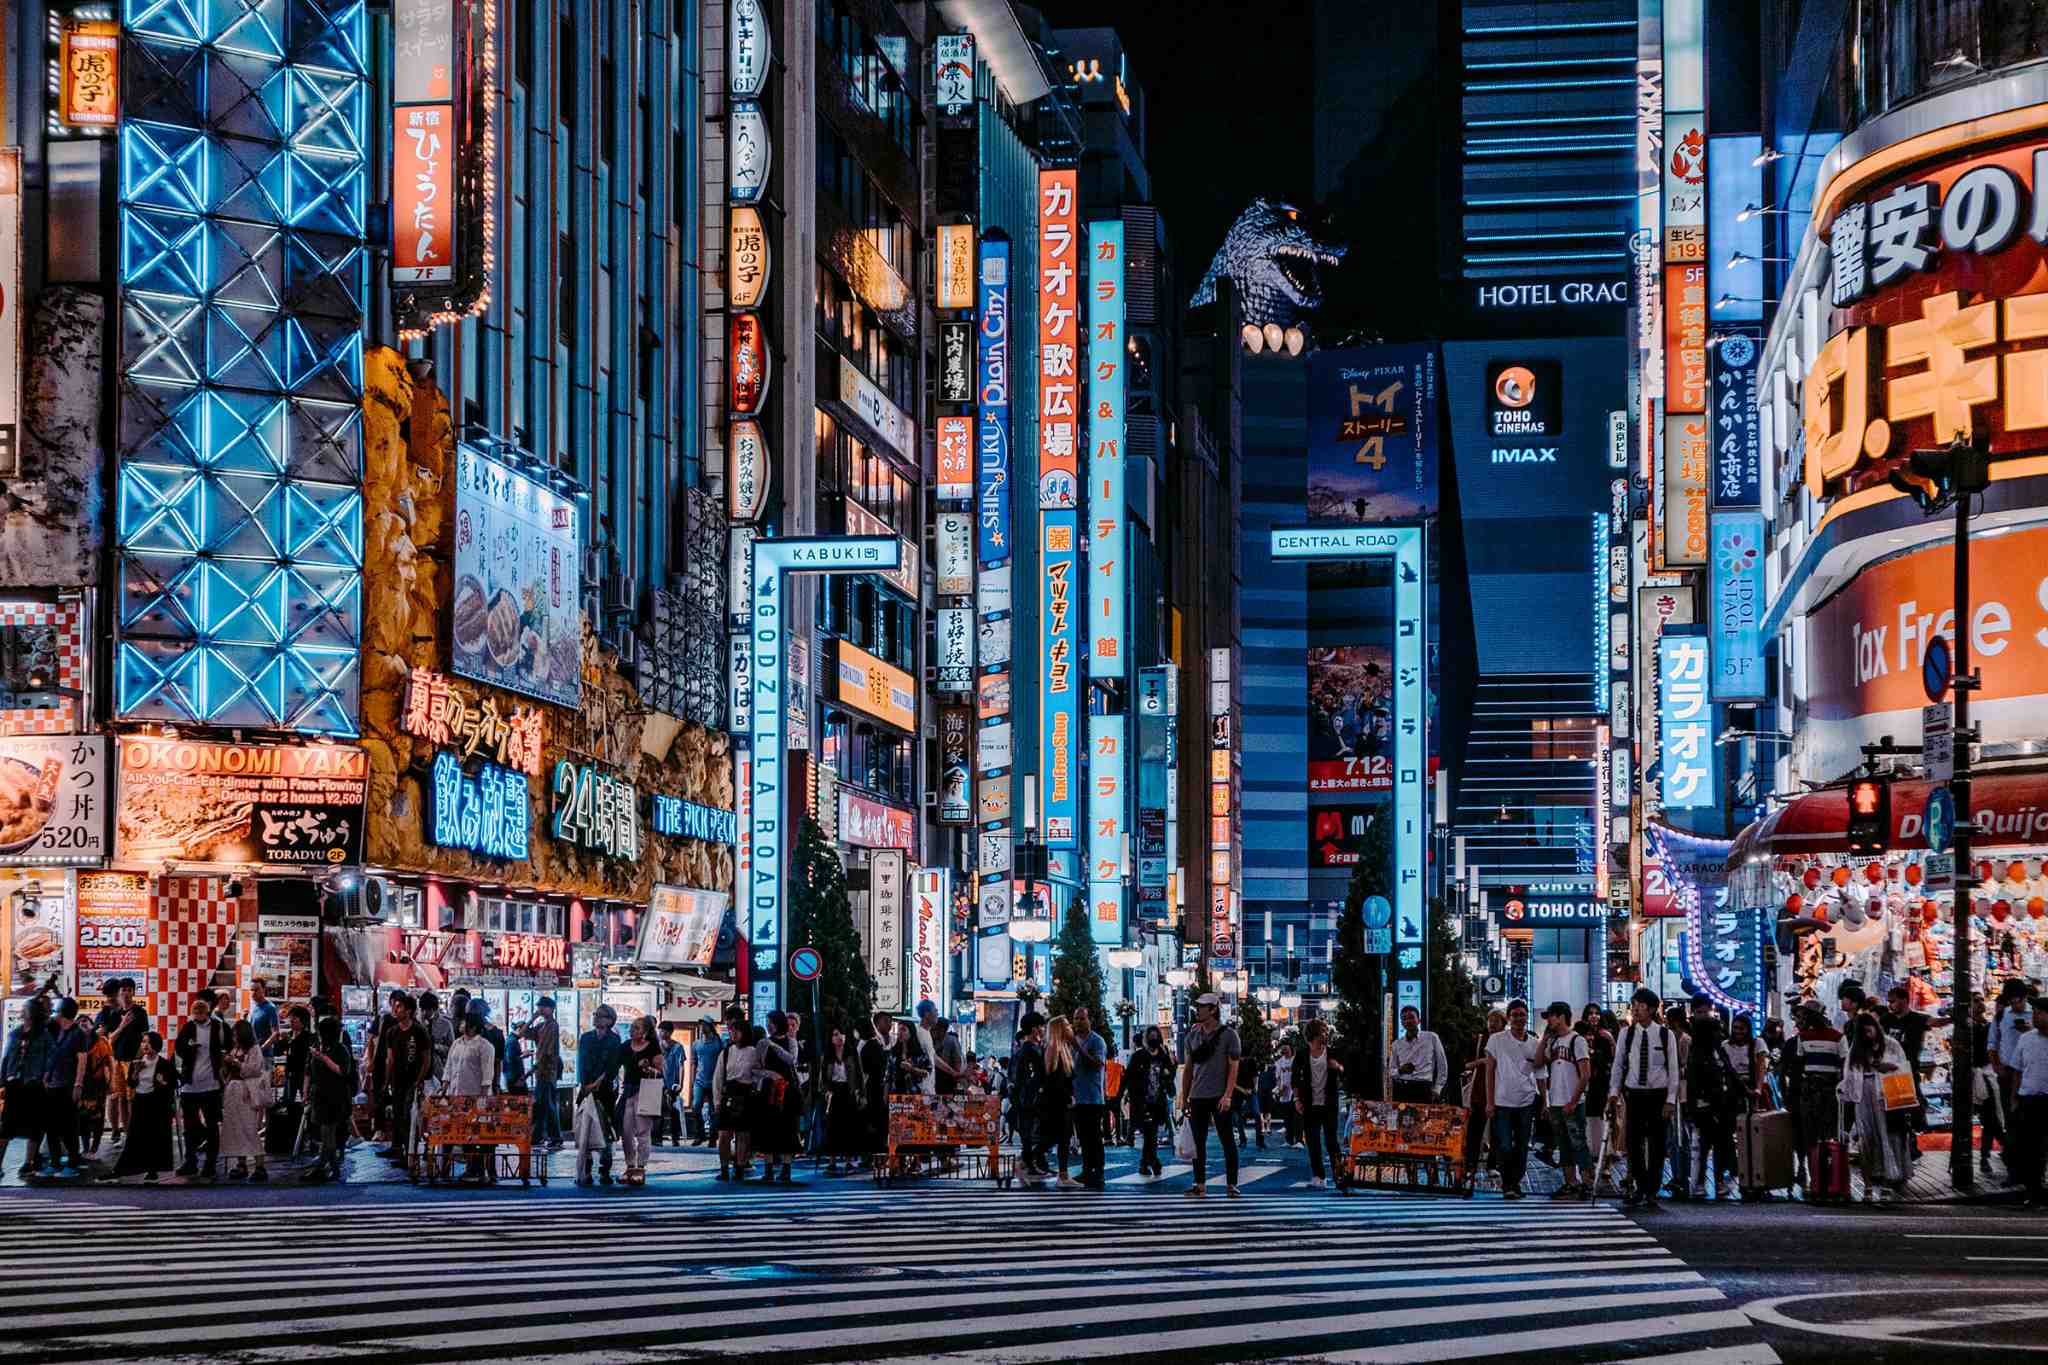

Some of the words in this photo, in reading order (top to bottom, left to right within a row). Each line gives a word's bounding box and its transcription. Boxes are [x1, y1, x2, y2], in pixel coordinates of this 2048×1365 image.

[78, 53, 107, 103] 虎の子
[734, 77, 757, 91] 6F
[409, 111, 441, 126] 新宿
[406, 128, 441, 262] ひょうたん
[415, 268, 434, 279] 7F
[735, 235, 760, 284] 虎の子
[1479, 285, 1557, 306] HOTEL
[1043, 182, 1073, 457] カラオケ歌広場
[1349, 380, 1404, 416] トイ
[1344, 418, 1406, 435] ストーリー
[1495, 411, 1532, 423] TOHO
[1495, 422, 1545, 433] CINEMAS
[1096, 240, 1118, 656] カラオケ&パーティー館
[1355, 436, 1387, 471] 4
[1491, 448, 1556, 464] IMAX
[793, 547, 879, 561] KABUKI町
[1278, 536, 1350, 549] CENTRAL
[1355, 534, 1398, 547] ROAD
[1724, 578, 1739, 639] STAGE
[1739, 579, 1753, 626] IDOL
[1048, 560, 1071, 694] マツモトキヨシ
[1725, 657, 1753, 677] 5F
[1853, 622, 1888, 688] Tax
[757, 605, 777, 796] GODZILLA
[1669, 643, 1708, 799] カラオケ
[127, 742, 281, 774] OKONOMI
[293, 750, 365, 777] YAKI
[1343, 756, 1387, 776] 7.12
[1399, 617, 1420, 884] ゴジラロード
[71, 741, 96, 821] かつ丼
[220, 790, 260, 802] Drinks
[260, 792, 278, 802] for
[291, 792, 325, 803] hours
[262, 779, 288, 789] with
[556, 760, 637, 862] 24時間
[656, 795, 682, 836] THE
[1096, 735, 1118, 920] カラオケ館
[42, 825, 100, 849] 520円
[266, 849, 326, 860] TORADYU
[756, 819, 776, 911] ROAD
[1679, 862, 1731, 874] KARAOK
[1528, 903, 1573, 918] TOHO
